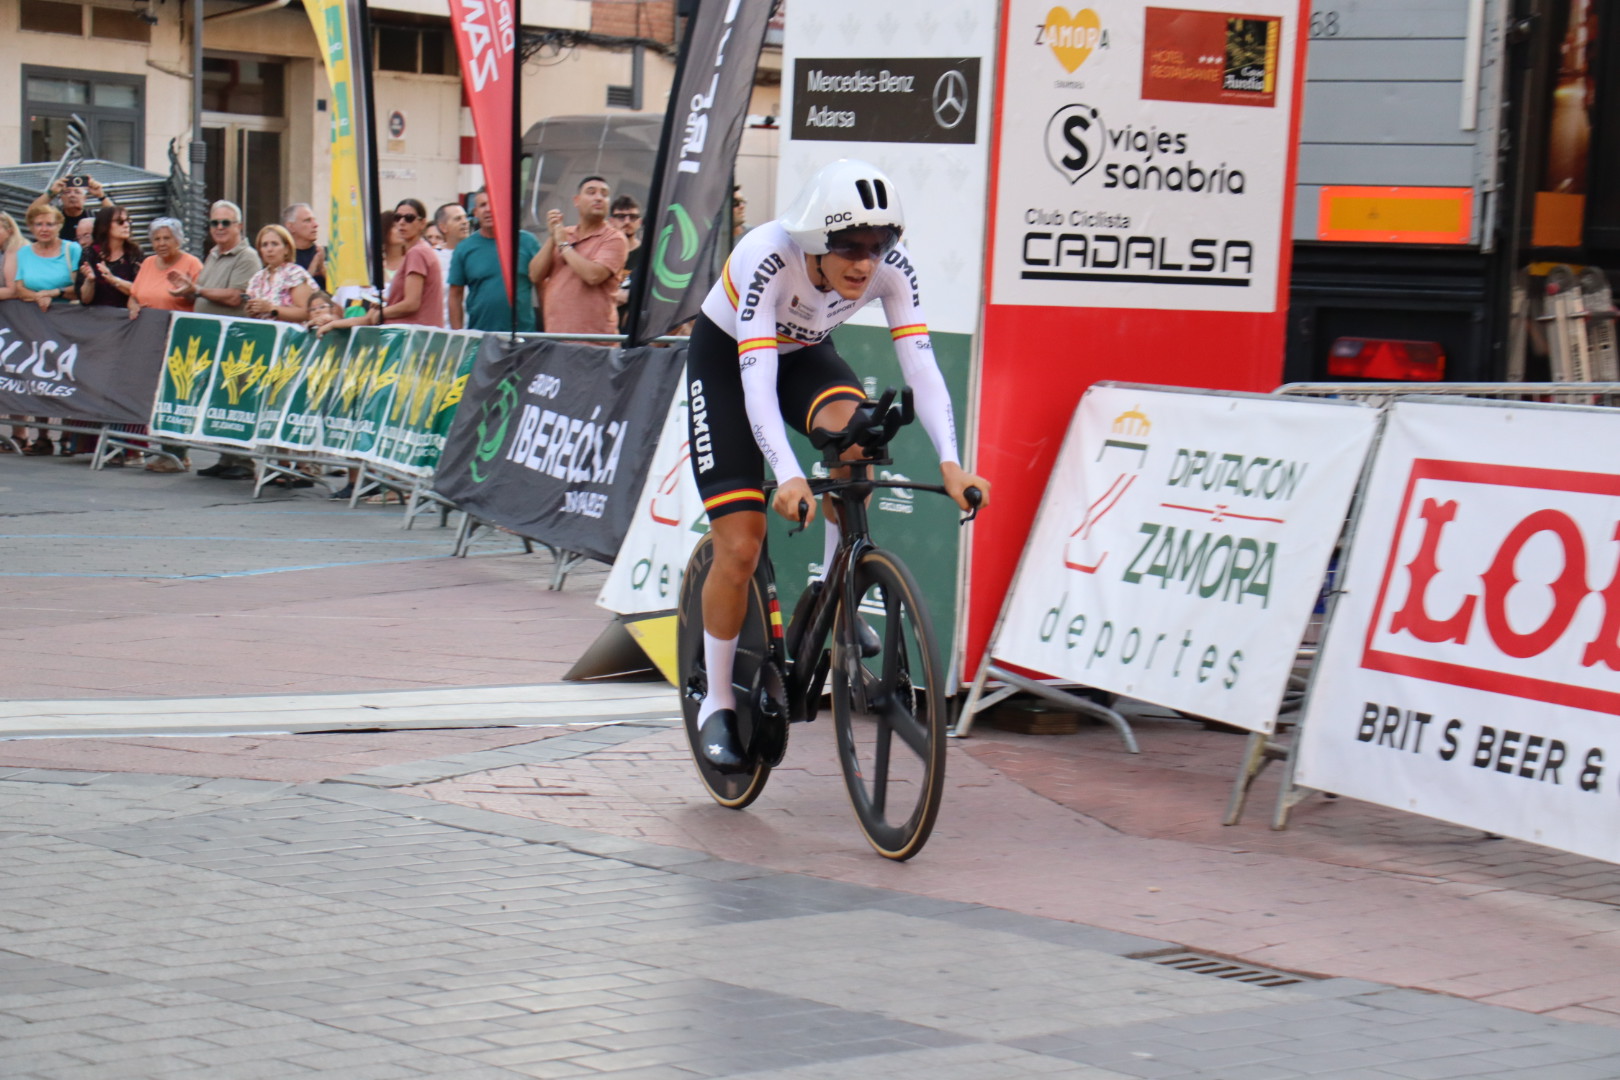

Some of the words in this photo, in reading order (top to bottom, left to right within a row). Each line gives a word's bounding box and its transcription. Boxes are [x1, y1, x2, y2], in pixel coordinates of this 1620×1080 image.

[1034, 24, 1111, 50] ZAMORA
[807, 70, 914, 93] Mercedes-Benz
[806, 105, 856, 127] Adarsa
[1109, 124, 1188, 163] viajes
[1103, 160, 1245, 194] sanabria
[1025, 208, 1064, 226] Club
[1069, 209, 1131, 229] Ciclista
[1023, 231, 1253, 273] CADALSA
[741, 253, 786, 321] GOMUR
[691, 379, 715, 474] GOMUR
[1122, 522, 1278, 609] ZAMORA
[1039, 590, 1245, 689] deportes
[1357, 701, 1433, 753] BRIT
[1472, 725, 1567, 785] BEER
[1579, 747, 1604, 793] &
